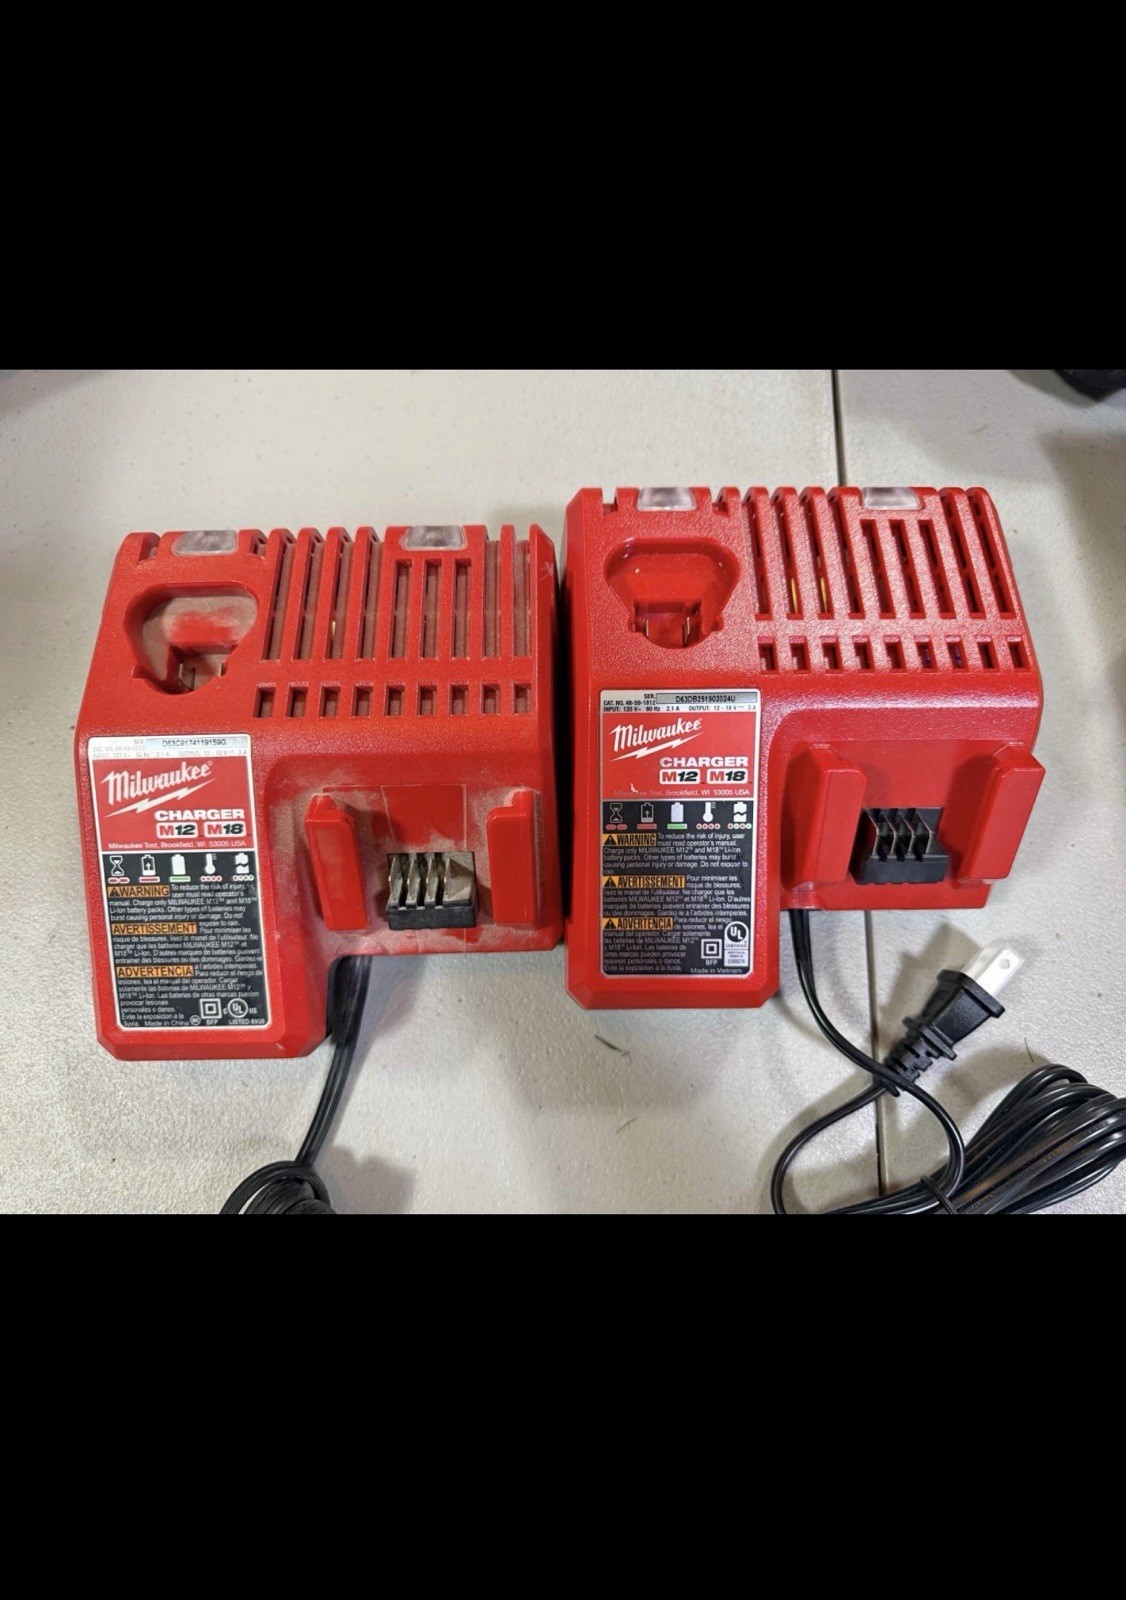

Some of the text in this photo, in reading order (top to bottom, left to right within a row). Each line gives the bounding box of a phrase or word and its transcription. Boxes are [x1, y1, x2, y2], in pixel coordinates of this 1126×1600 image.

[660, 756, 748, 767] CHARGER
[662, 771, 745, 782] M12 M18
[155, 809, 245, 821] CHARGER
[160, 824, 244, 836] M12 M18
[617, 835, 656, 846] WARNING
[618, 877, 684, 887] AVERTISSEMENT
[120, 887, 169, 896] WARNING
[114, 924, 195, 933] AVERTISSEMENT
[618, 919, 672, 929] ADVERTENCIA
[730, 927, 743, 940] UL
[118, 967, 192, 977] ADVERTENCIA
